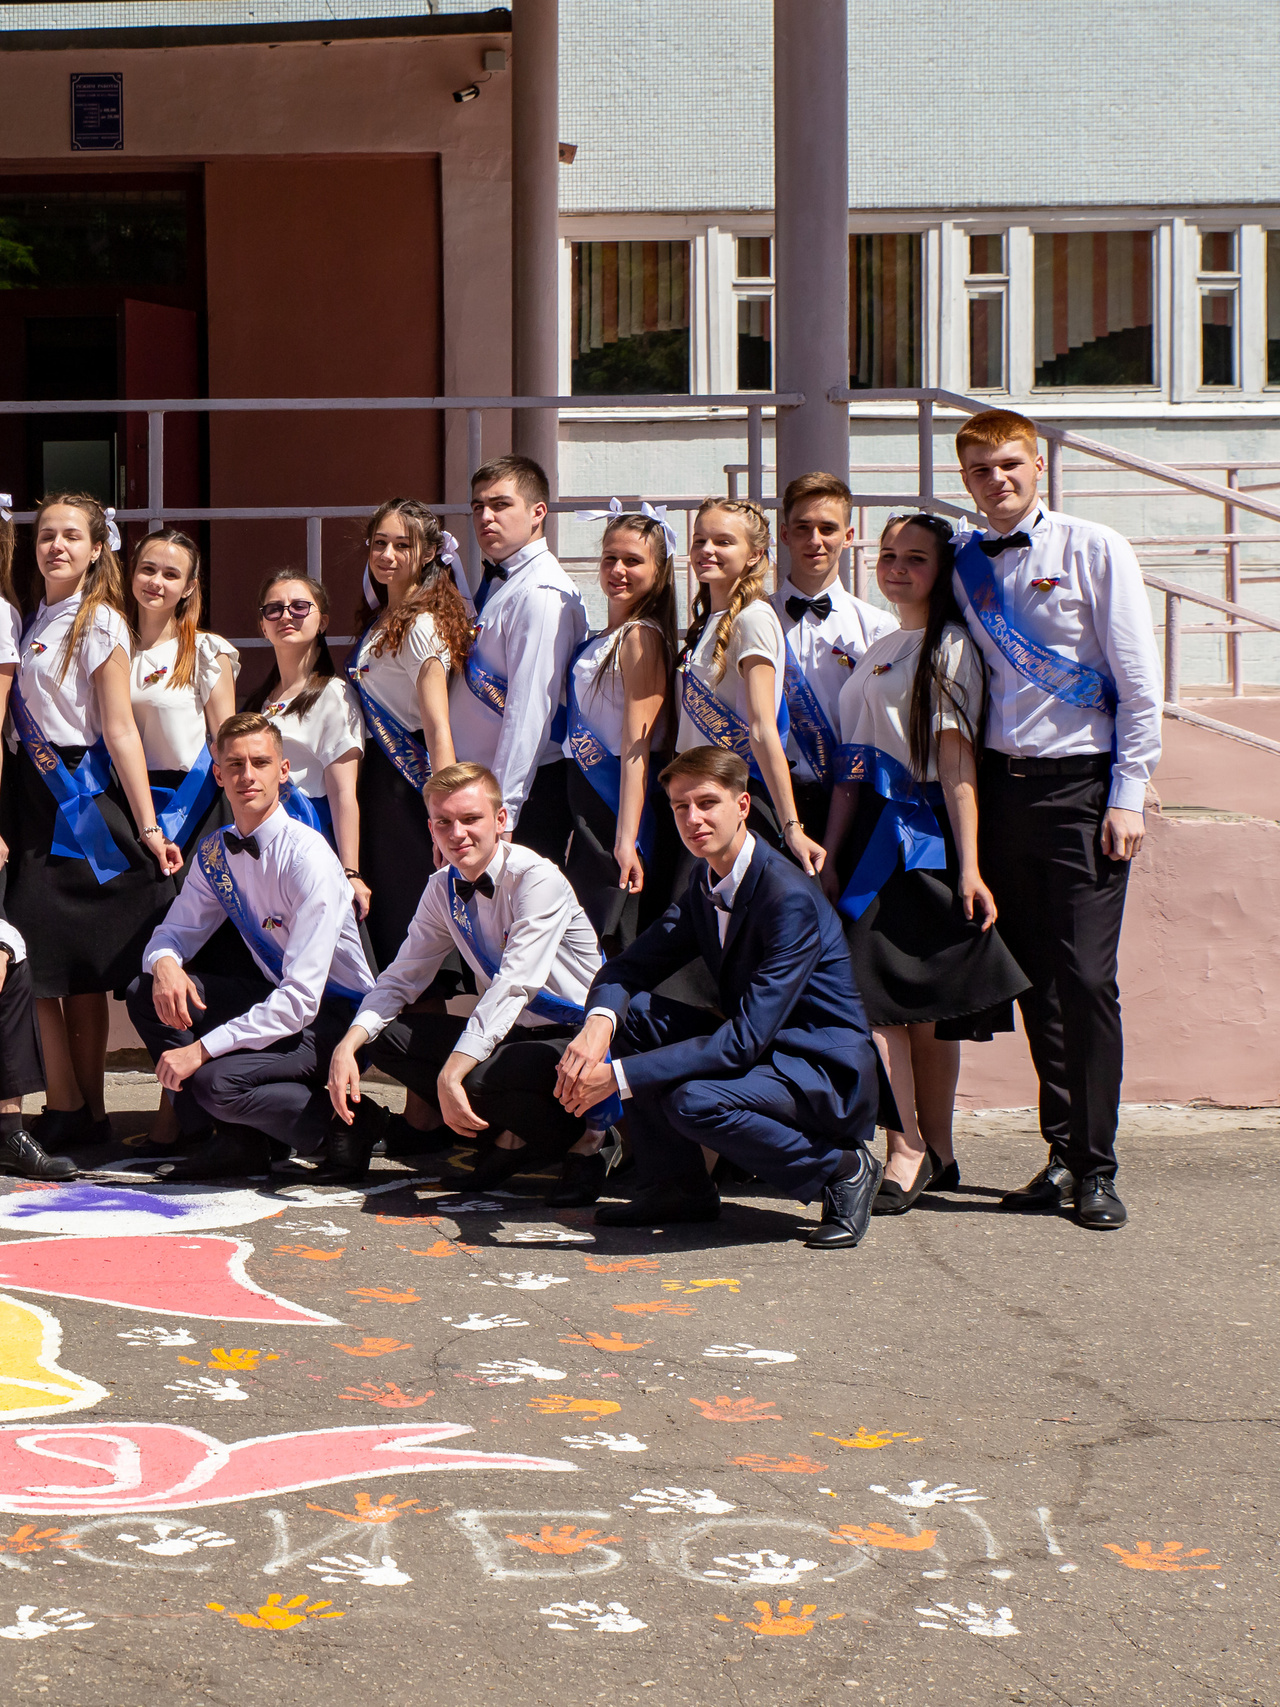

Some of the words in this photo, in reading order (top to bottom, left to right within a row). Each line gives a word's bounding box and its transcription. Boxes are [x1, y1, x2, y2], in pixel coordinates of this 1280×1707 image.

[988, 613, 1082, 692] Выпускник
[28, 737, 57, 771] 2019
[571, 731, 602, 766] 2019
